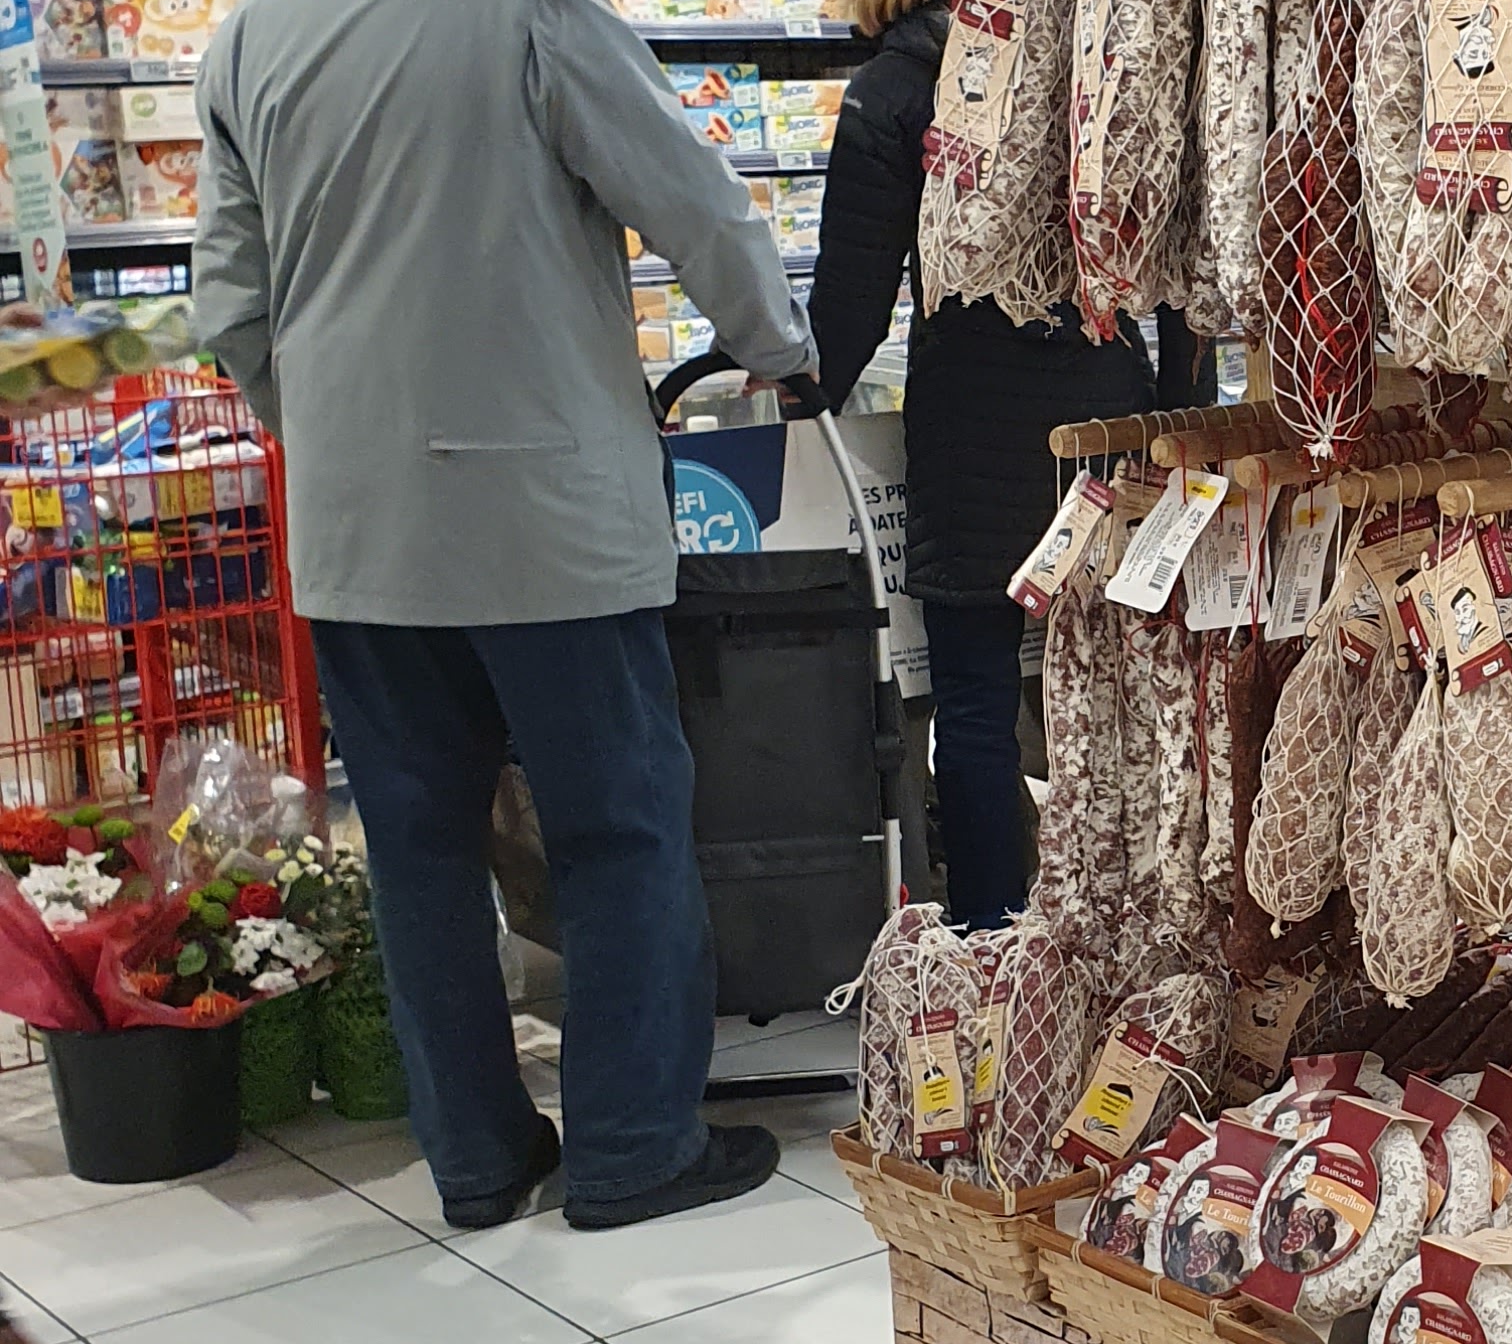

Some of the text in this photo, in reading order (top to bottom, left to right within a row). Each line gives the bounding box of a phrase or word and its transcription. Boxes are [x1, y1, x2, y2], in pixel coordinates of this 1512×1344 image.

[1310, 1180, 1367, 1214] Le Tourillon
[1207, 1203, 1220, 1216] Le
